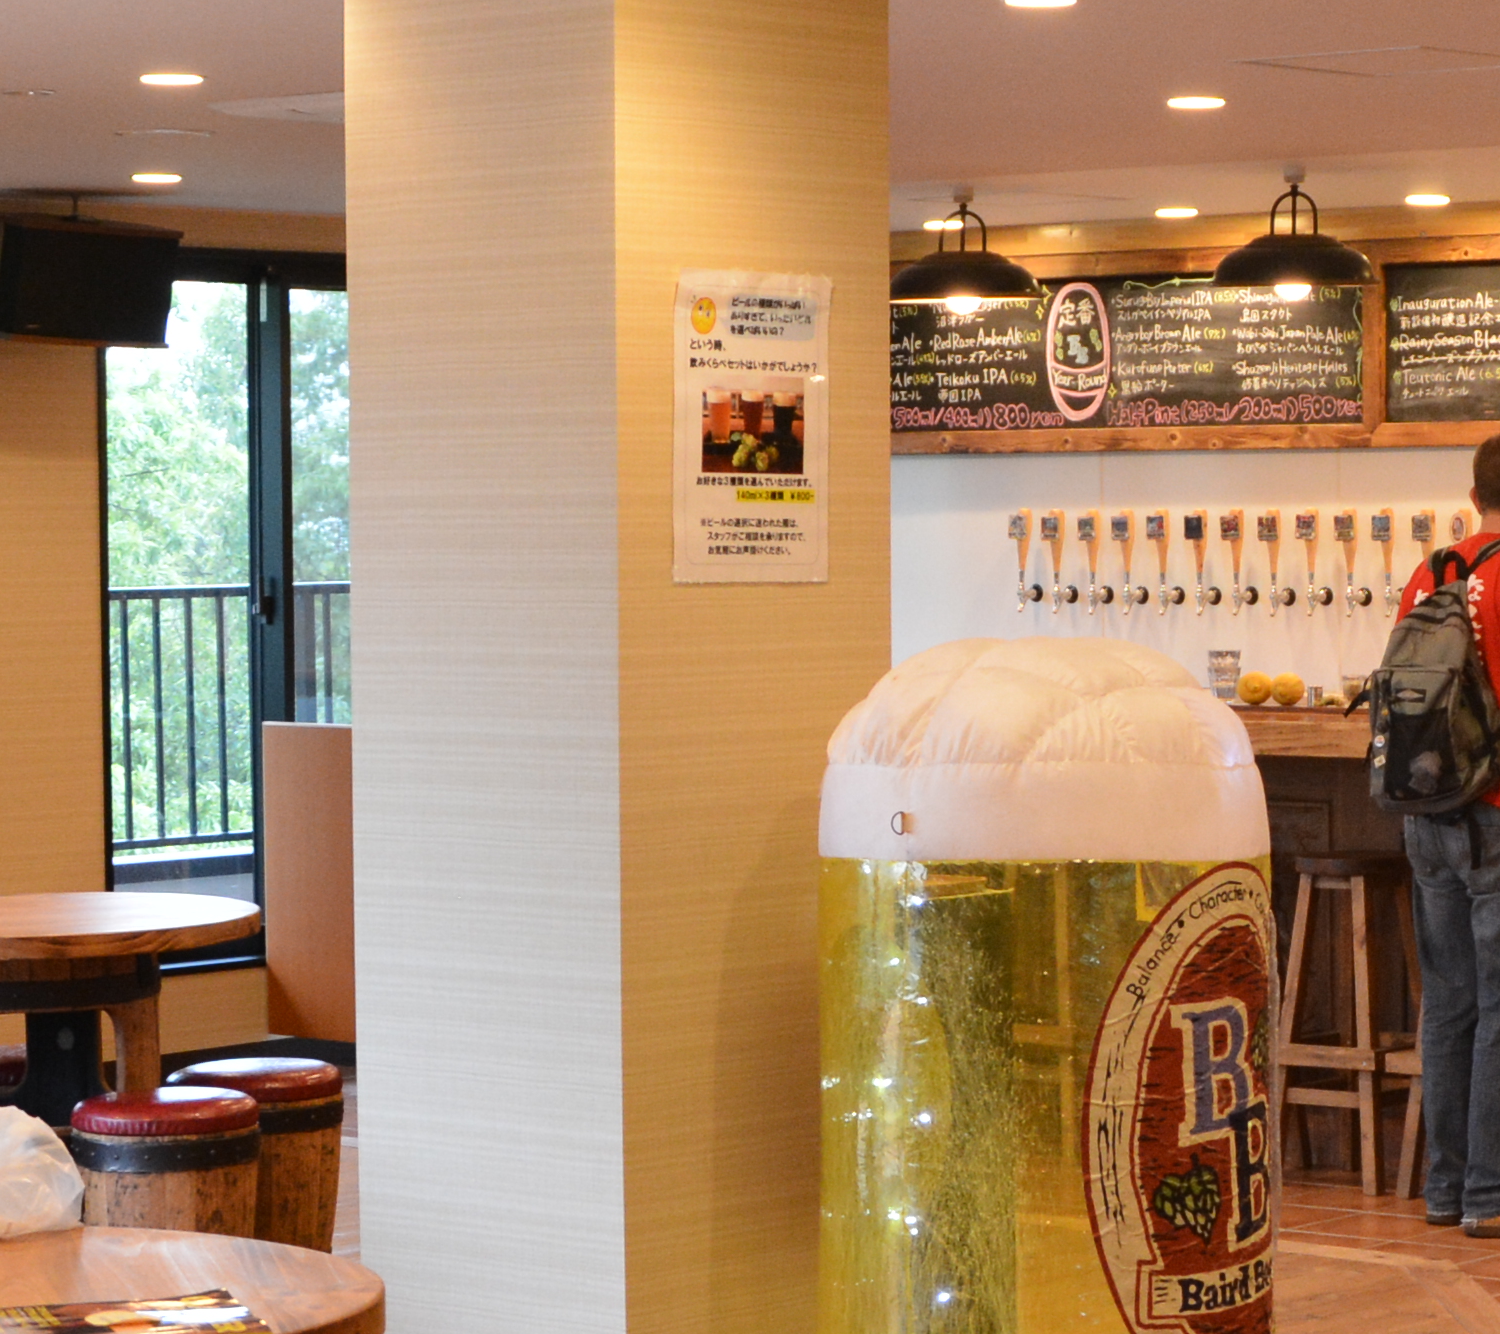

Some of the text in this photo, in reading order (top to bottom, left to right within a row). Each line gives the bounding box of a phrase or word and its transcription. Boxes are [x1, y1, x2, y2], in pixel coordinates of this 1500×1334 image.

[1058, 298, 1095, 328] 定番
[1126, 932, 1179, 999] Balance
[1188, 885, 1247, 919] Character
[1178, 1263, 1252, 1313] Baird
